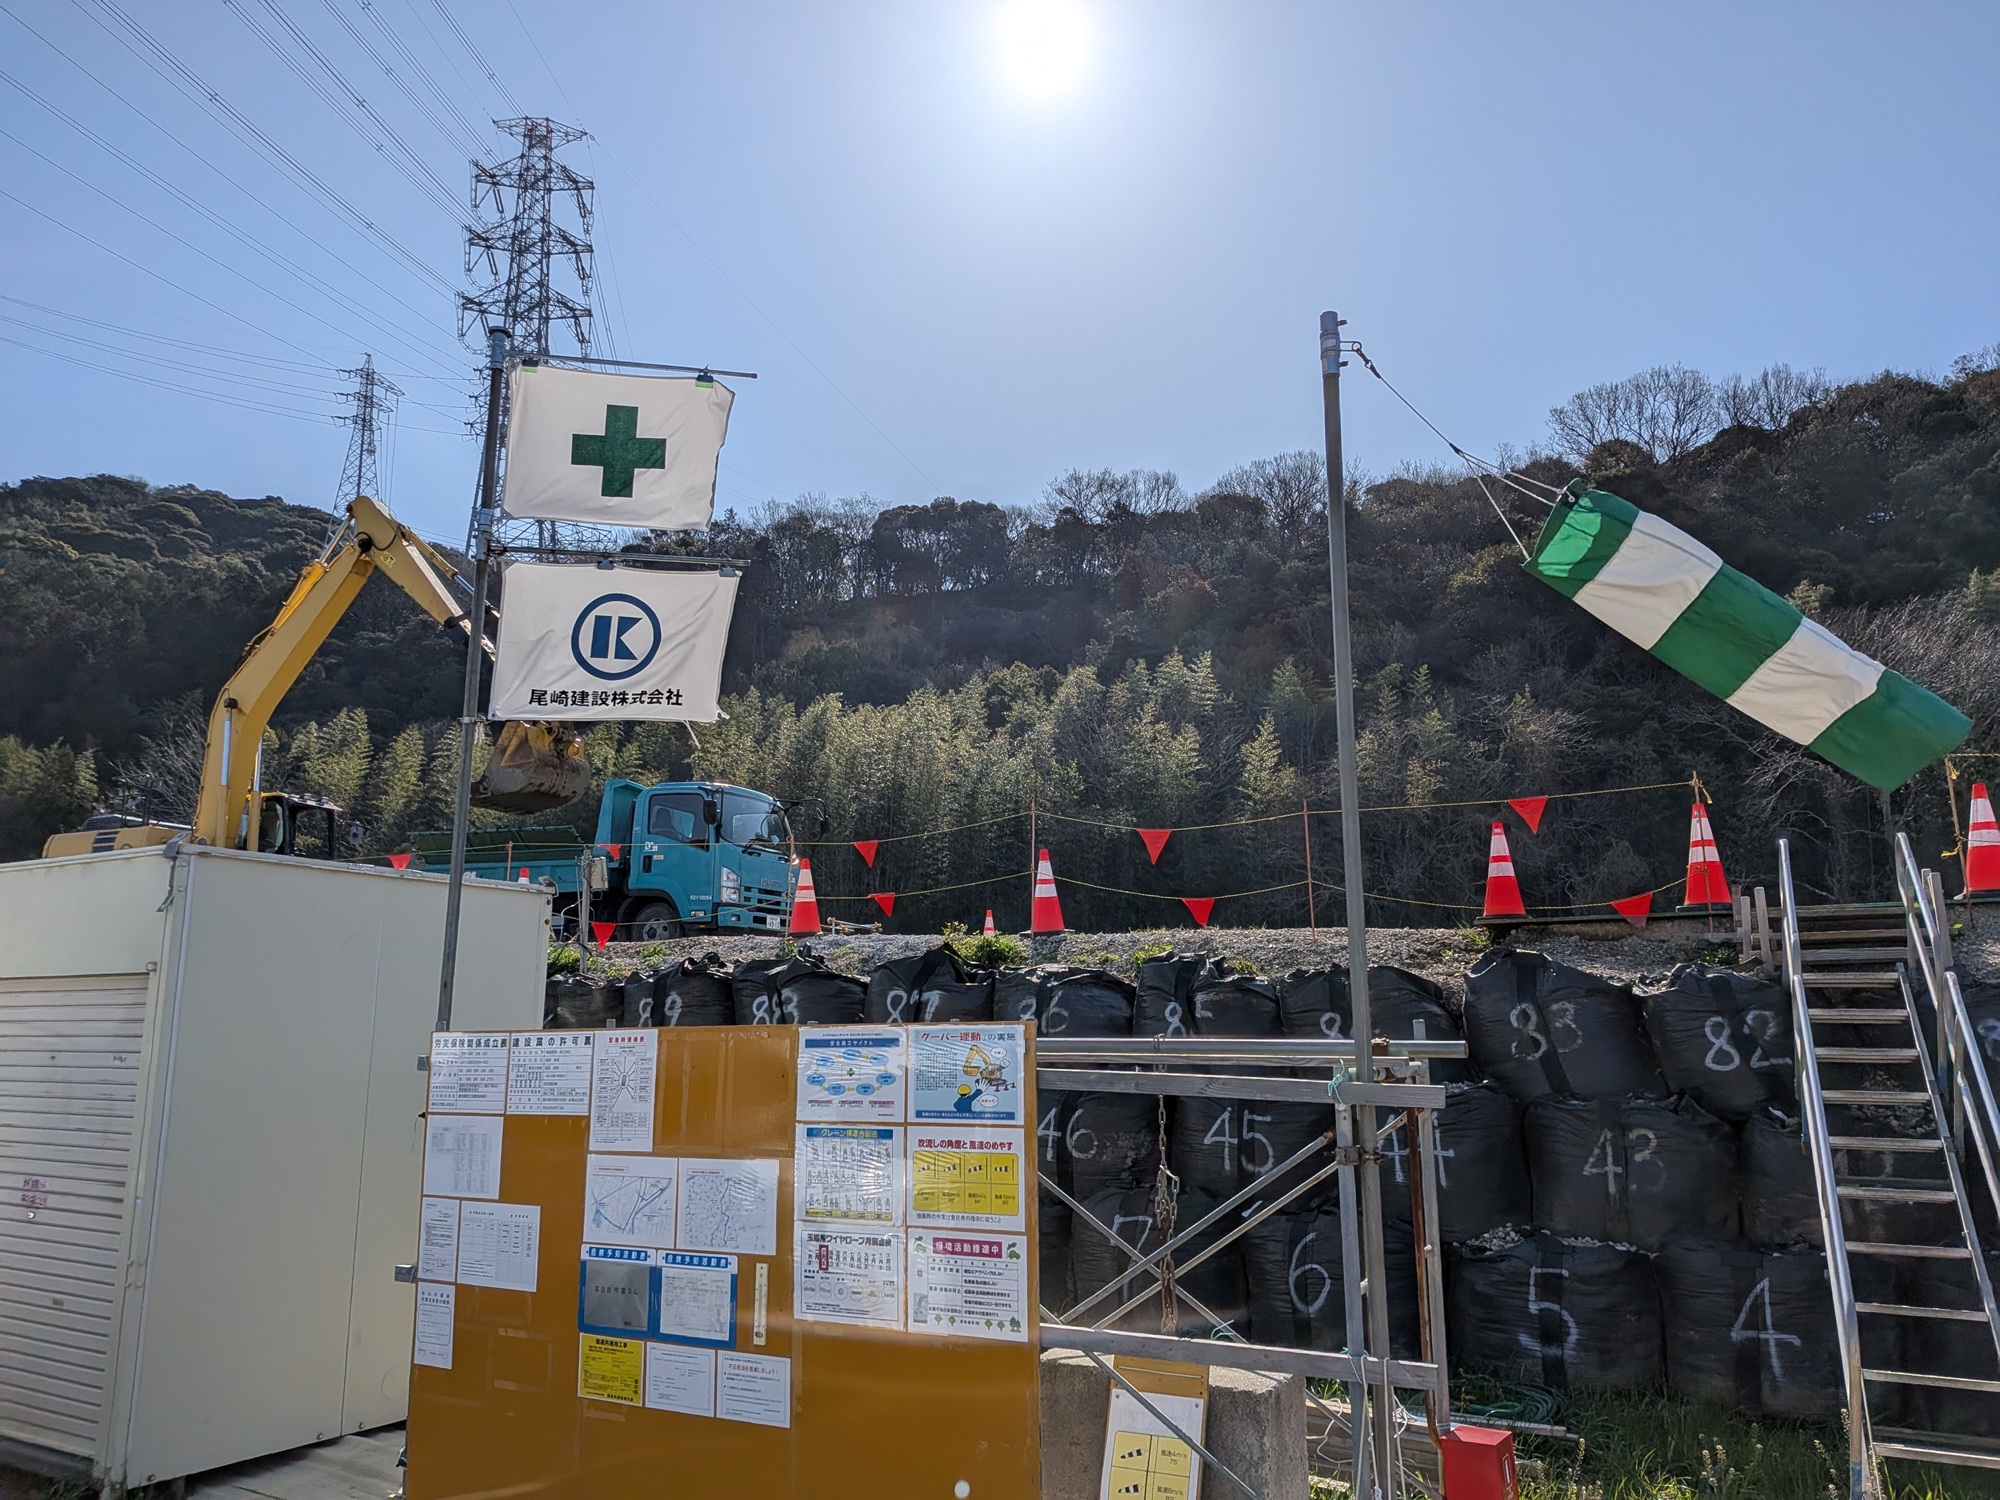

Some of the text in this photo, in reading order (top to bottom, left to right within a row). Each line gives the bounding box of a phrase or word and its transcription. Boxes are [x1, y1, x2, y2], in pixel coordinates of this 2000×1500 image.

[528, 688, 683, 707] 尾崎建設株式会社
[1705, 1010, 1793, 1071] 82
[1038, 1107, 1098, 1162] 46
[1204, 1107, 1275, 1175] 45
[1582, 1127, 1667, 1195] 43
[935, 1241, 999, 1255] 環境活動推進中
[1288, 1232, 1331, 1317] 6
[1518, 1264, 1580, 1355] 5
[1730, 1276, 1801, 1382] 4
